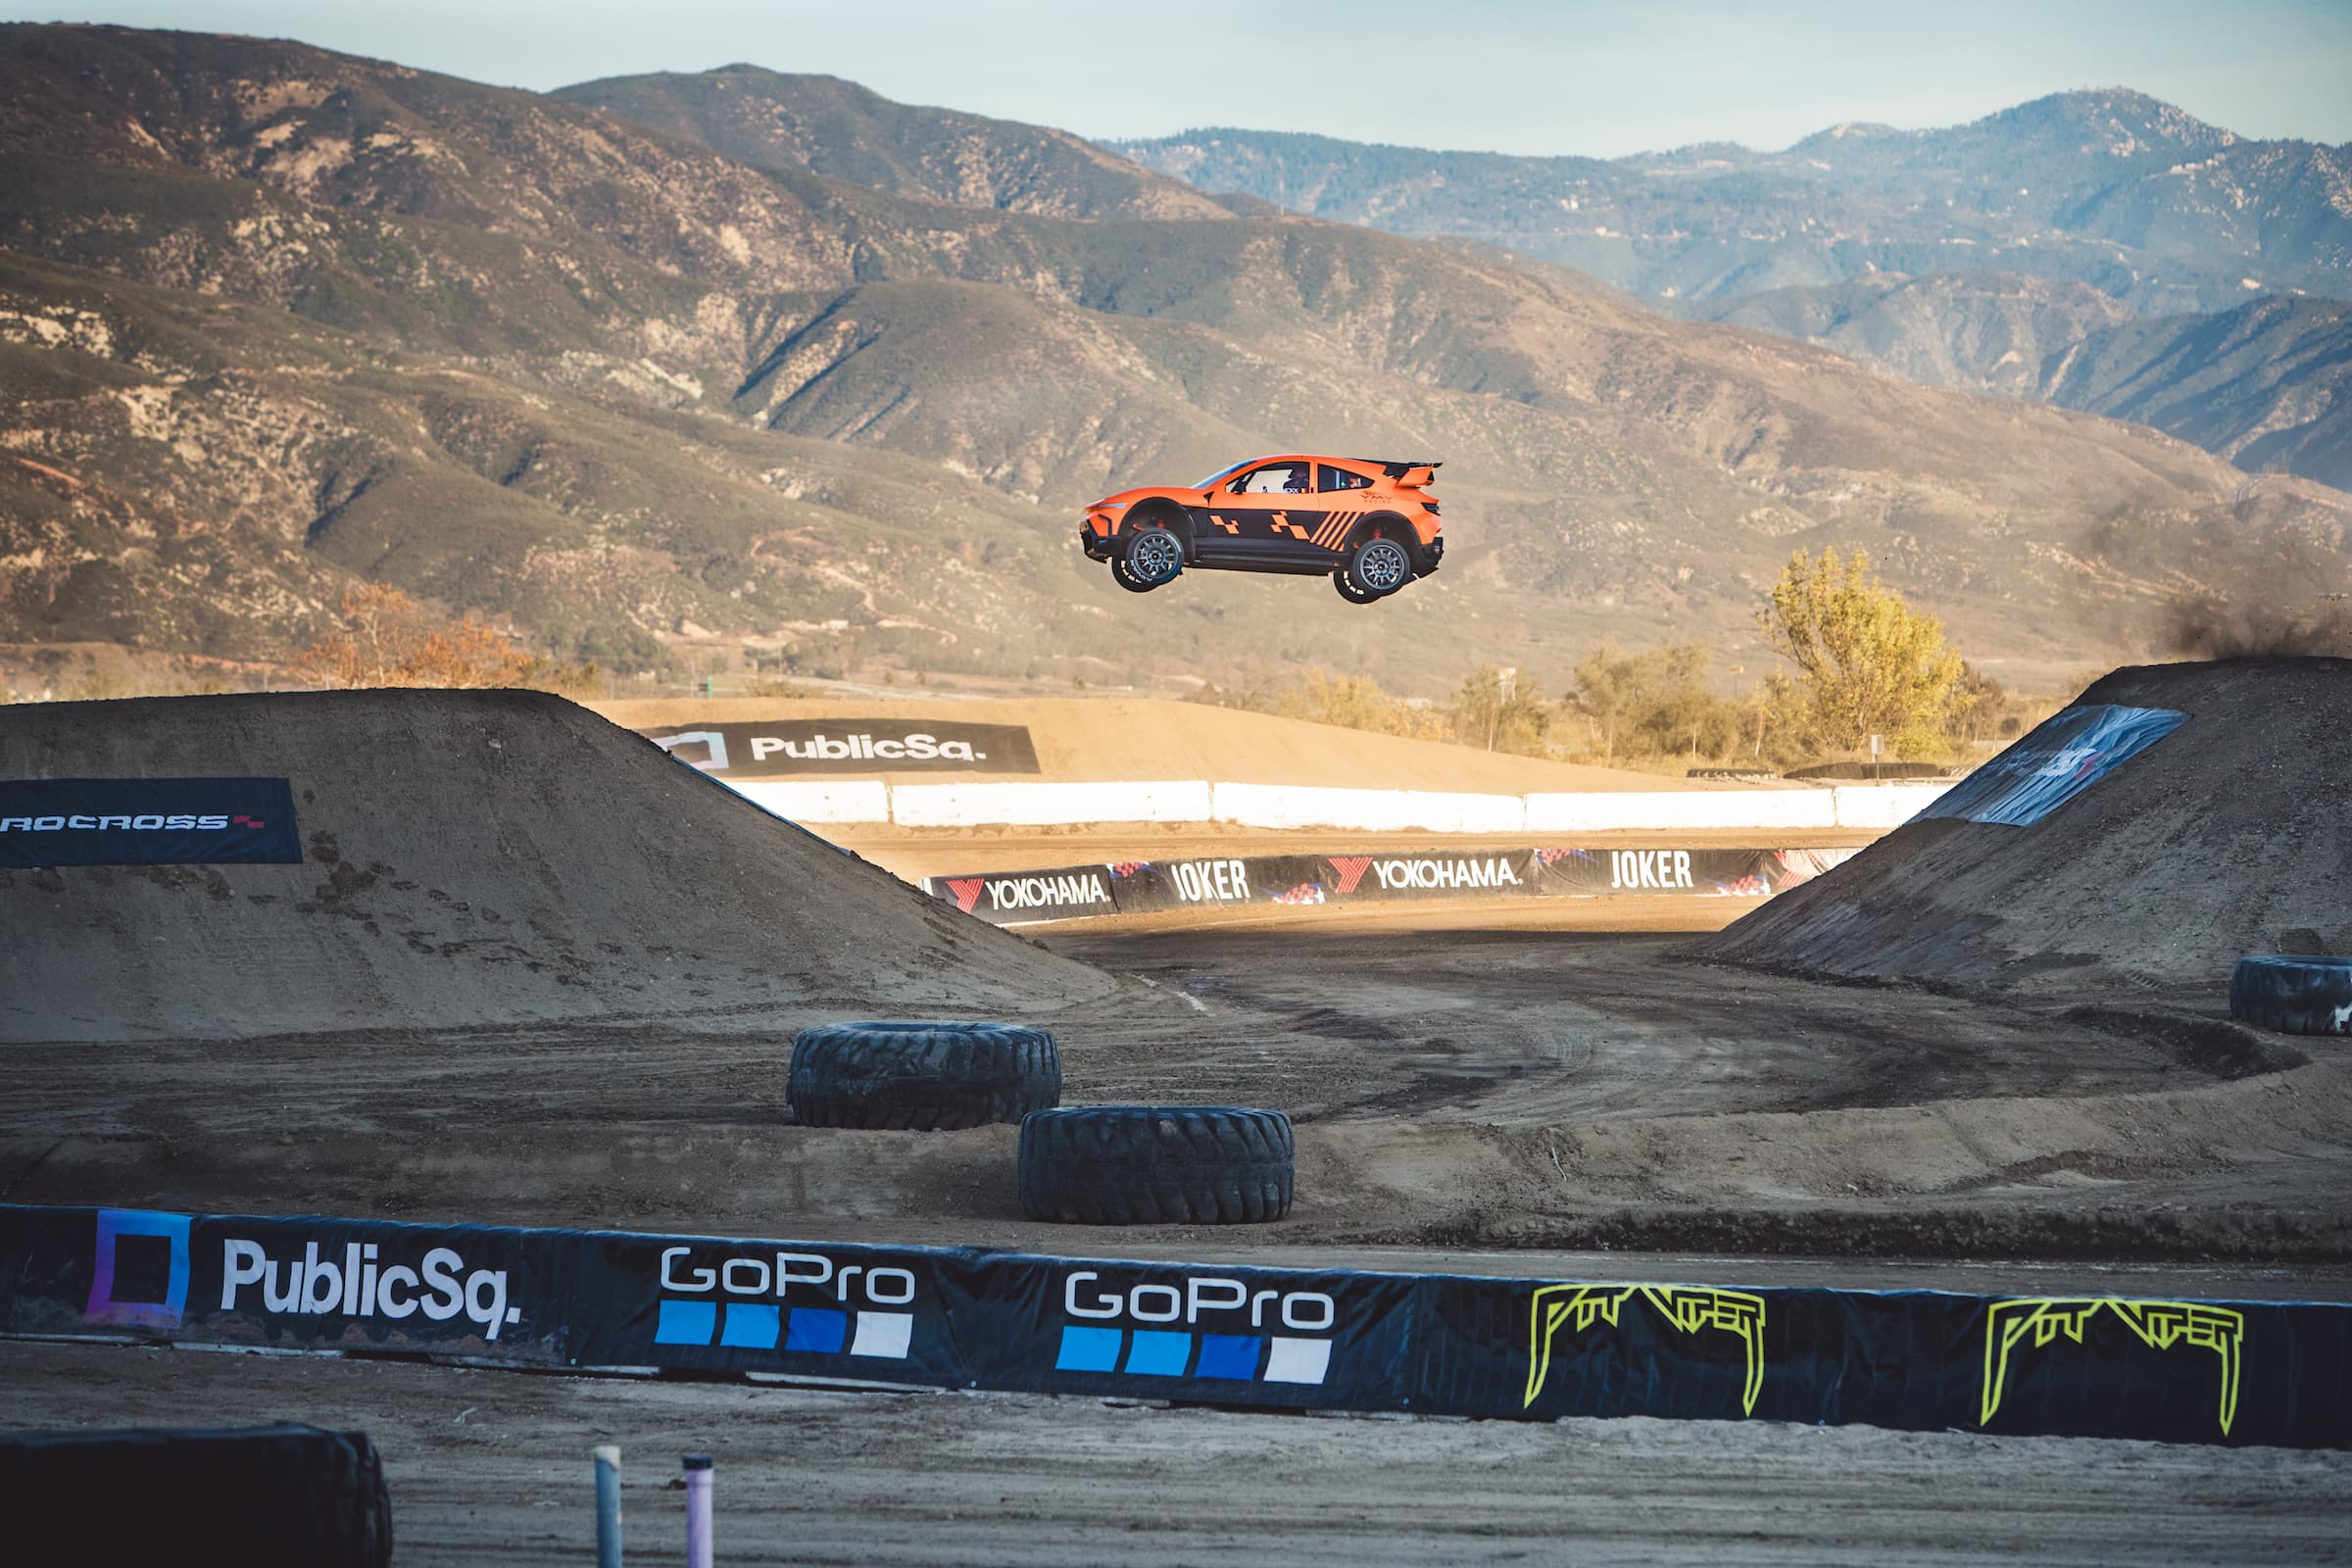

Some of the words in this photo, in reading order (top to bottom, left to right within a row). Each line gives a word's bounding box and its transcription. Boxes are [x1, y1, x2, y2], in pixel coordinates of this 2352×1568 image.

[750, 734, 987, 762] PublicSq.
[1171, 859, 1250, 902] JOKER
[1373, 858, 1517, 889] YOKOHAMA
[1611, 851, 1694, 889] JOKER
[986, 874, 1107, 909] YOKOHAMA
[220, 1239, 521, 1341] PublicSq.
[660, 1247, 915, 1304] GoPro
[1065, 1271, 1335, 1331] GoPro
